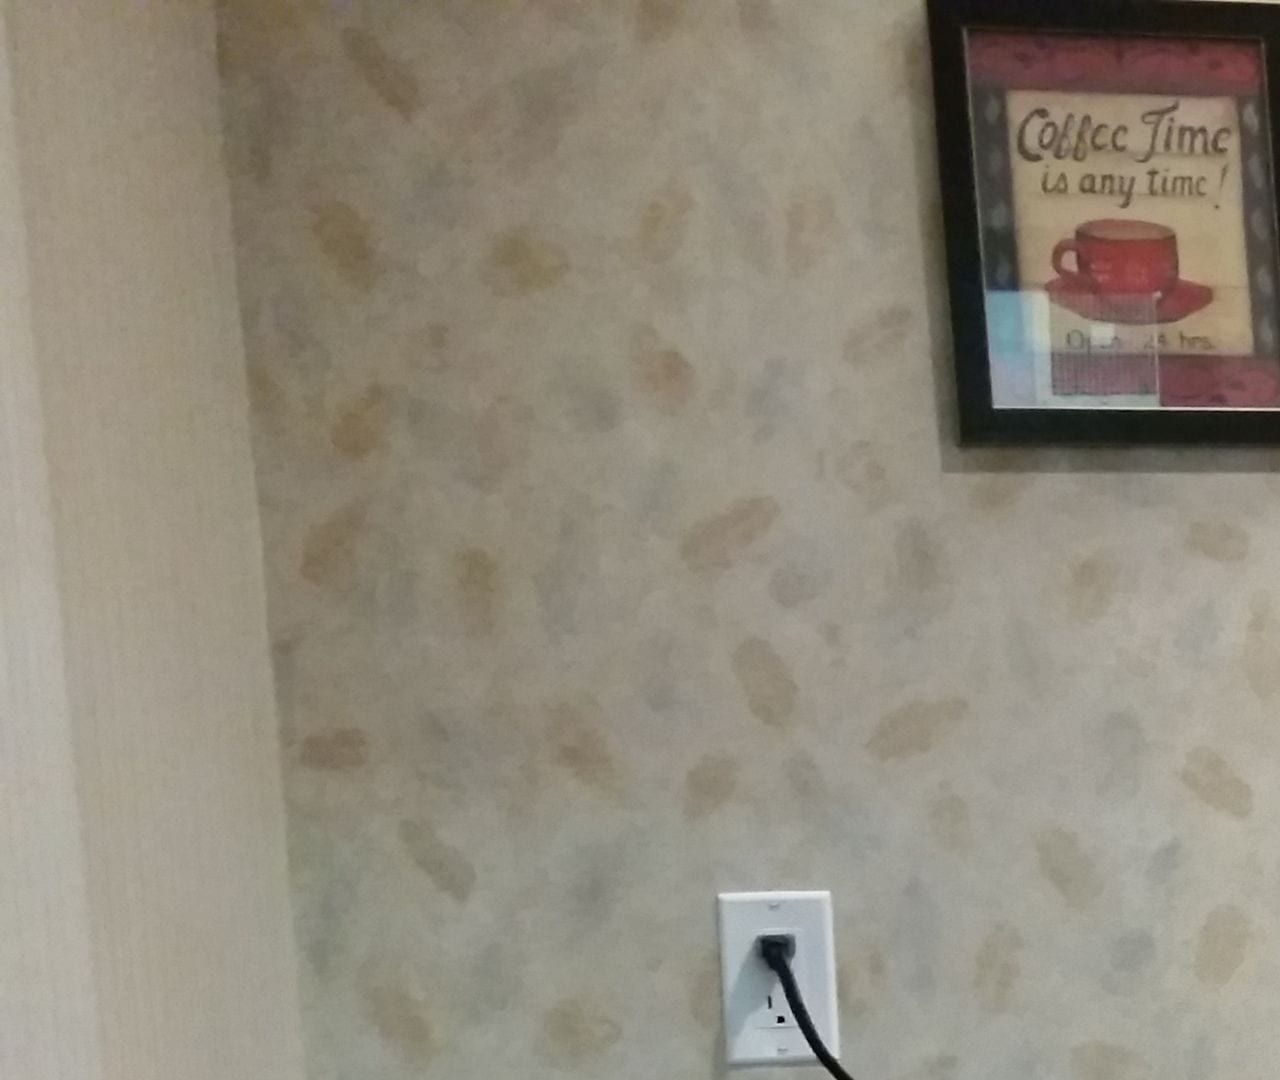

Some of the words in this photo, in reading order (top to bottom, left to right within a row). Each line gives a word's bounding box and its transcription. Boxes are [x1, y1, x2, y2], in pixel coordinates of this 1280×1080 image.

[1017, 107, 1128, 162] Coffee
[1134, 100, 1231, 163] Time
[1041, 165, 1068, 194] is
[1079, 172, 1135, 209] any
